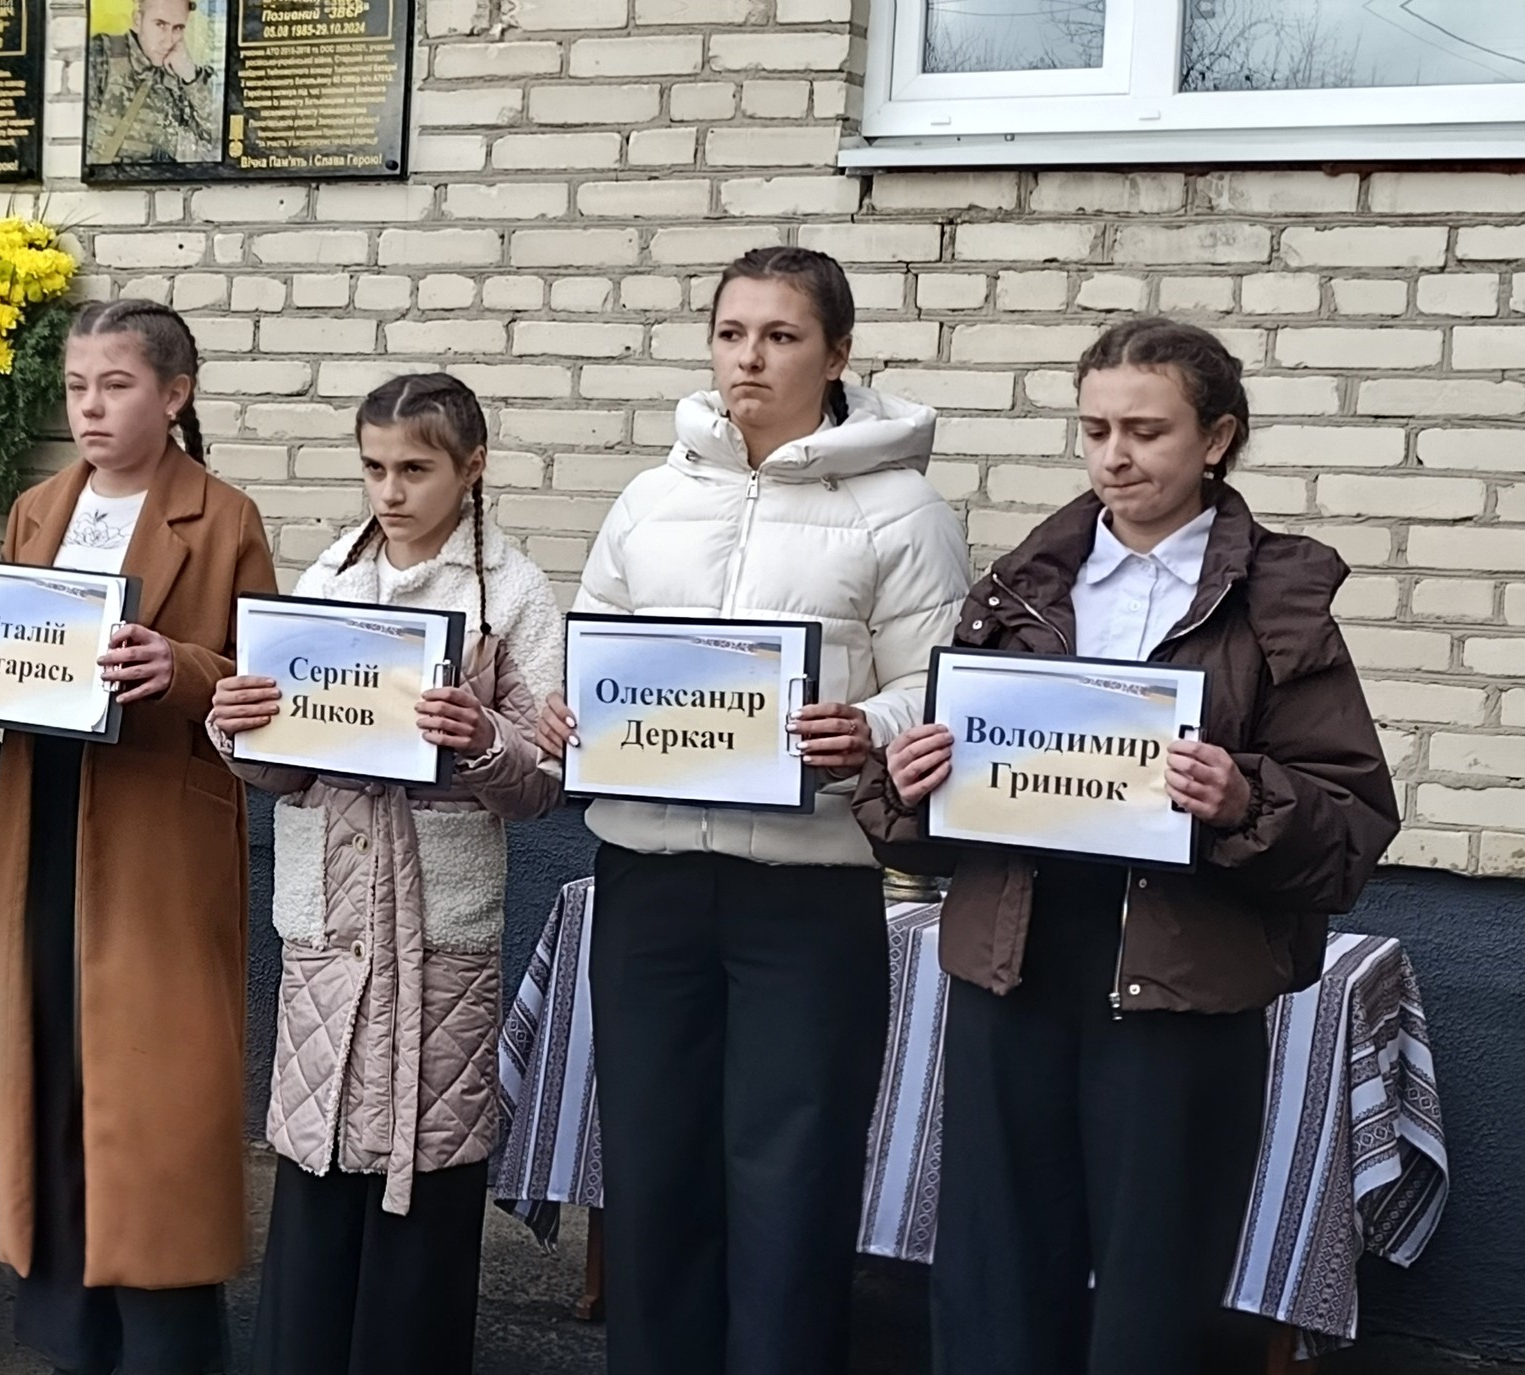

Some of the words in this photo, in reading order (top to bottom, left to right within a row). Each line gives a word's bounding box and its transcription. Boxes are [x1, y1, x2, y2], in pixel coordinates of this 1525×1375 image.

[262, 8, 320, 22] Позивний
[241, 155, 266, 168] Вічна
[269, 154, 307, 167] Пам'ять
[314, 154, 345, 166] Слава
[347, 153, 382, 168] Герою!
[288, 655, 380, 691] Сергій
[290, 694, 375, 727] Яцков
[594, 674, 766, 717] Олександр
[620, 718, 735, 754] Деркач
[962, 714, 1162, 768] Володимир
[987, 760, 1128, 803] Гринюк
